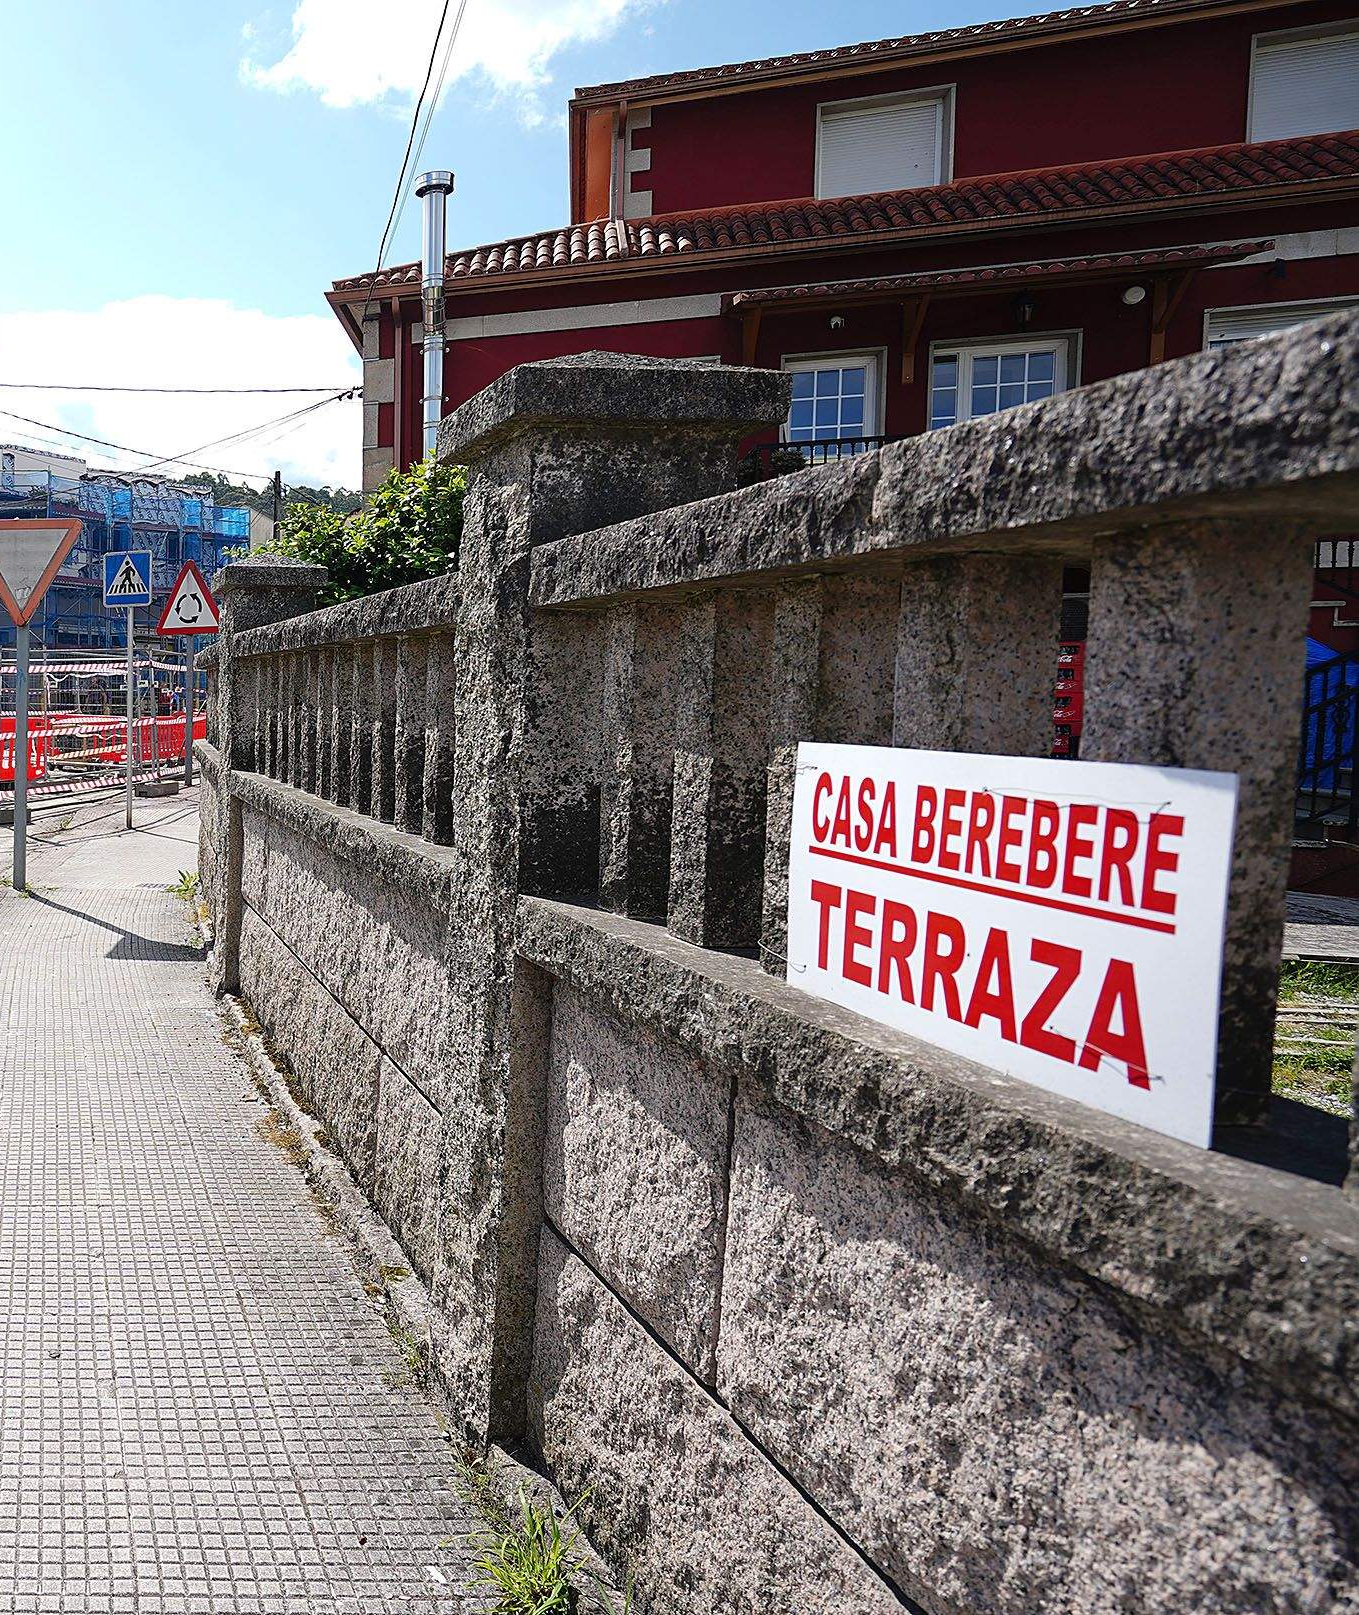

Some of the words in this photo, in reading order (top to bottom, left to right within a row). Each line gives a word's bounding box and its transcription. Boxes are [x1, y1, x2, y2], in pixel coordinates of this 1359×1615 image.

[812, 771, 897, 858] CASA
[911, 785, 1185, 915] BEREBERE
[810, 878, 1152, 1092] TERRAZA
